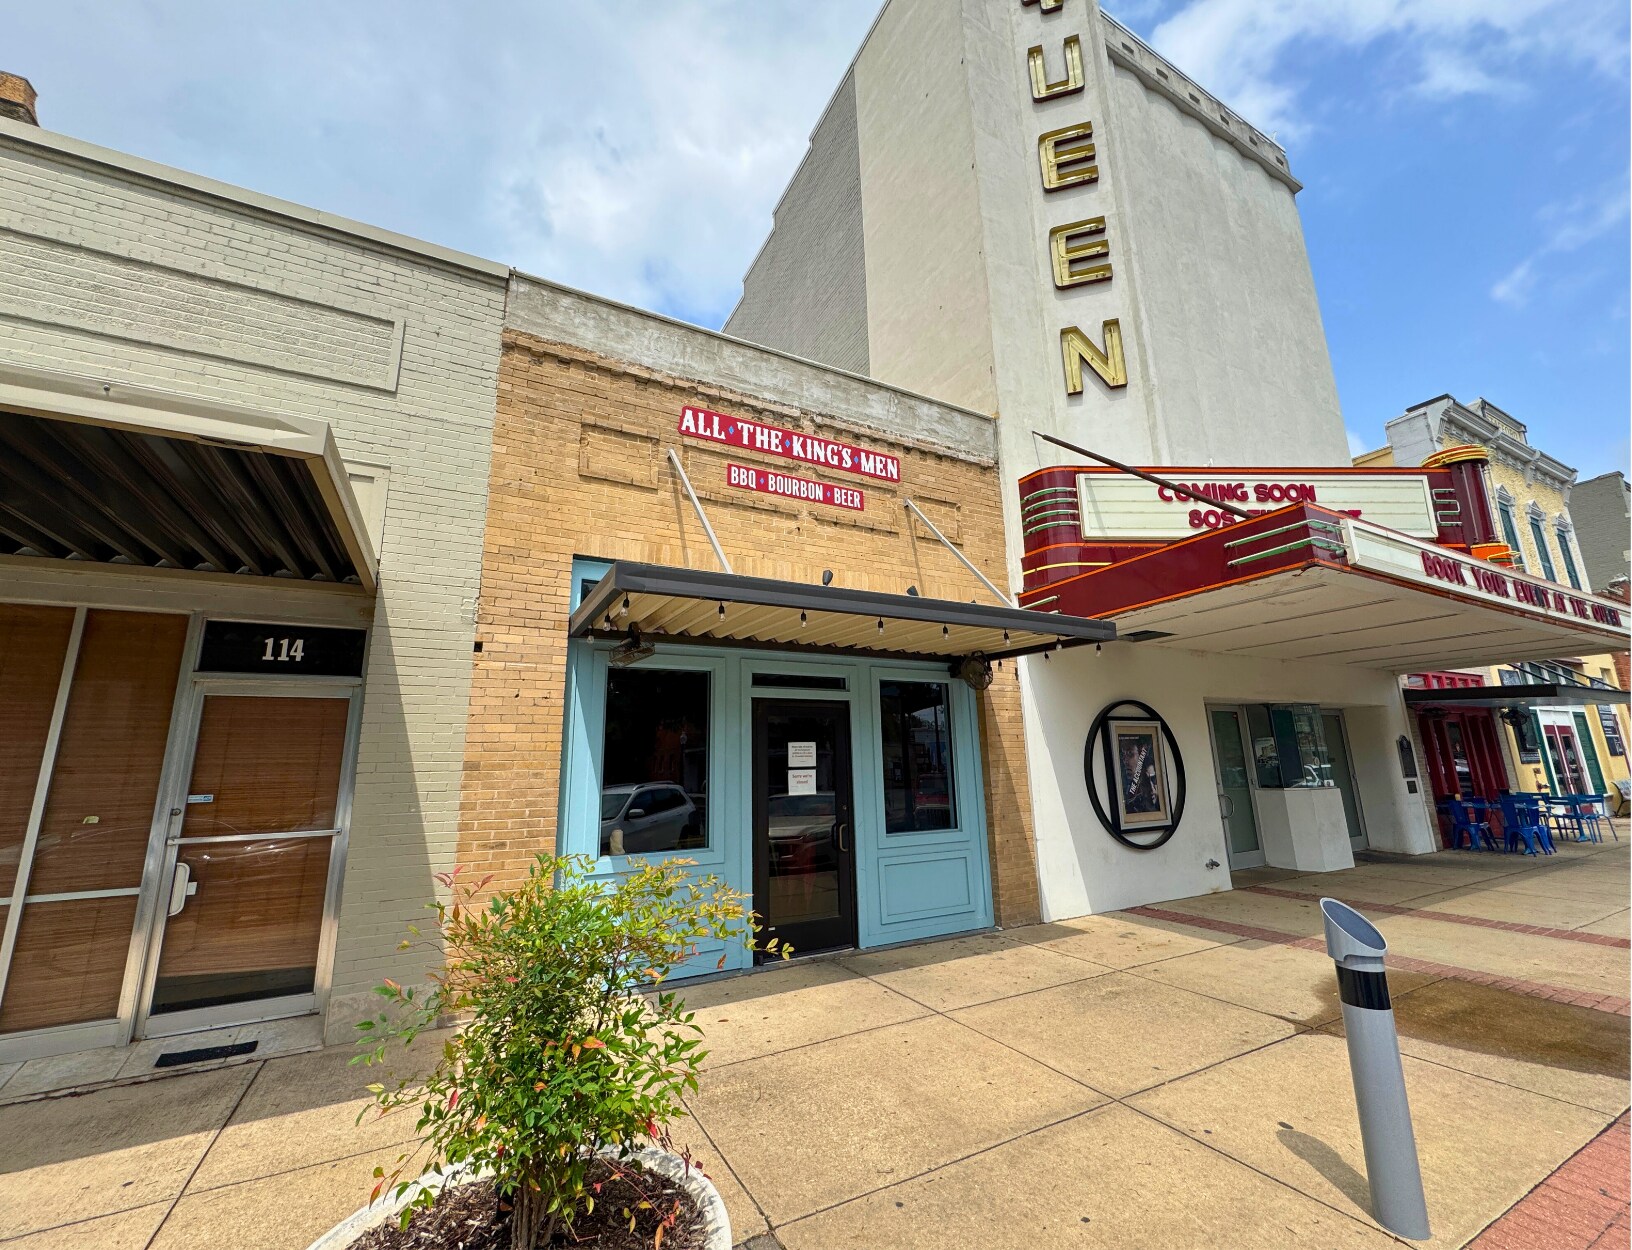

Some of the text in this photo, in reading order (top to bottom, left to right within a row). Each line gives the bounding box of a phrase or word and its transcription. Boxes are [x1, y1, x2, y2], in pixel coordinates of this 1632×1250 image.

[1020, 0, 1129, 397] UEEN
[681, 409, 899, 480] ALL THE KING'S MEN
[730, 466, 861, 509] BBQ BOURBON BEER
[1157, 482, 1317, 503] COMING SOON
[1420, 550, 1468, 587] BOOK
[1470, 566, 1511, 598] YOUR
[1512, 579, 1551, 609] EVENT
[1553, 591, 1567, 614] AT
[1569, 596, 1591, 620] THE
[262, 637, 304, 662] 114
